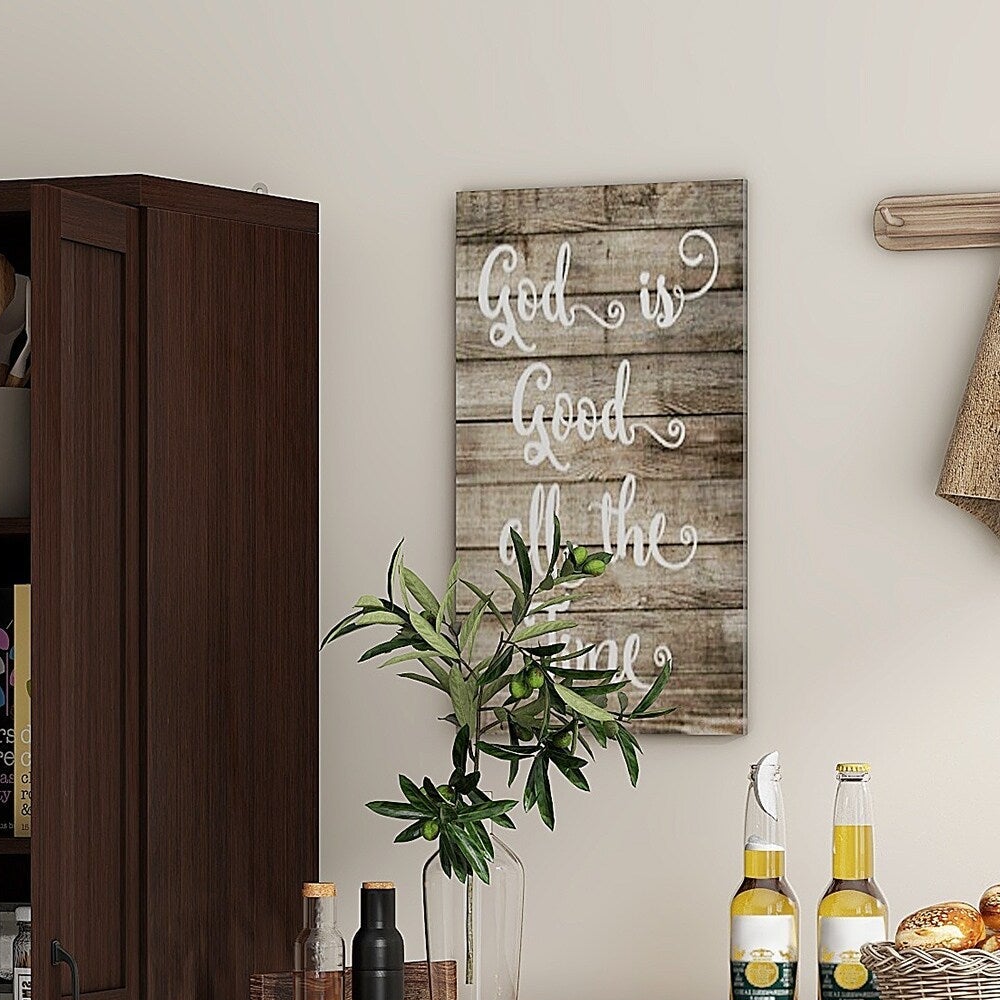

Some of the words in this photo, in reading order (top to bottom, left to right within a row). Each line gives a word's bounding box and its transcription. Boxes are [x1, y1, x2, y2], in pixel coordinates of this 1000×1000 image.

[478, 241, 625, 352] God
[639, 229, 719, 330] is
[512, 359, 685, 472] Good
[500, 483, 575, 584] all
[589, 473, 697, 570] the
